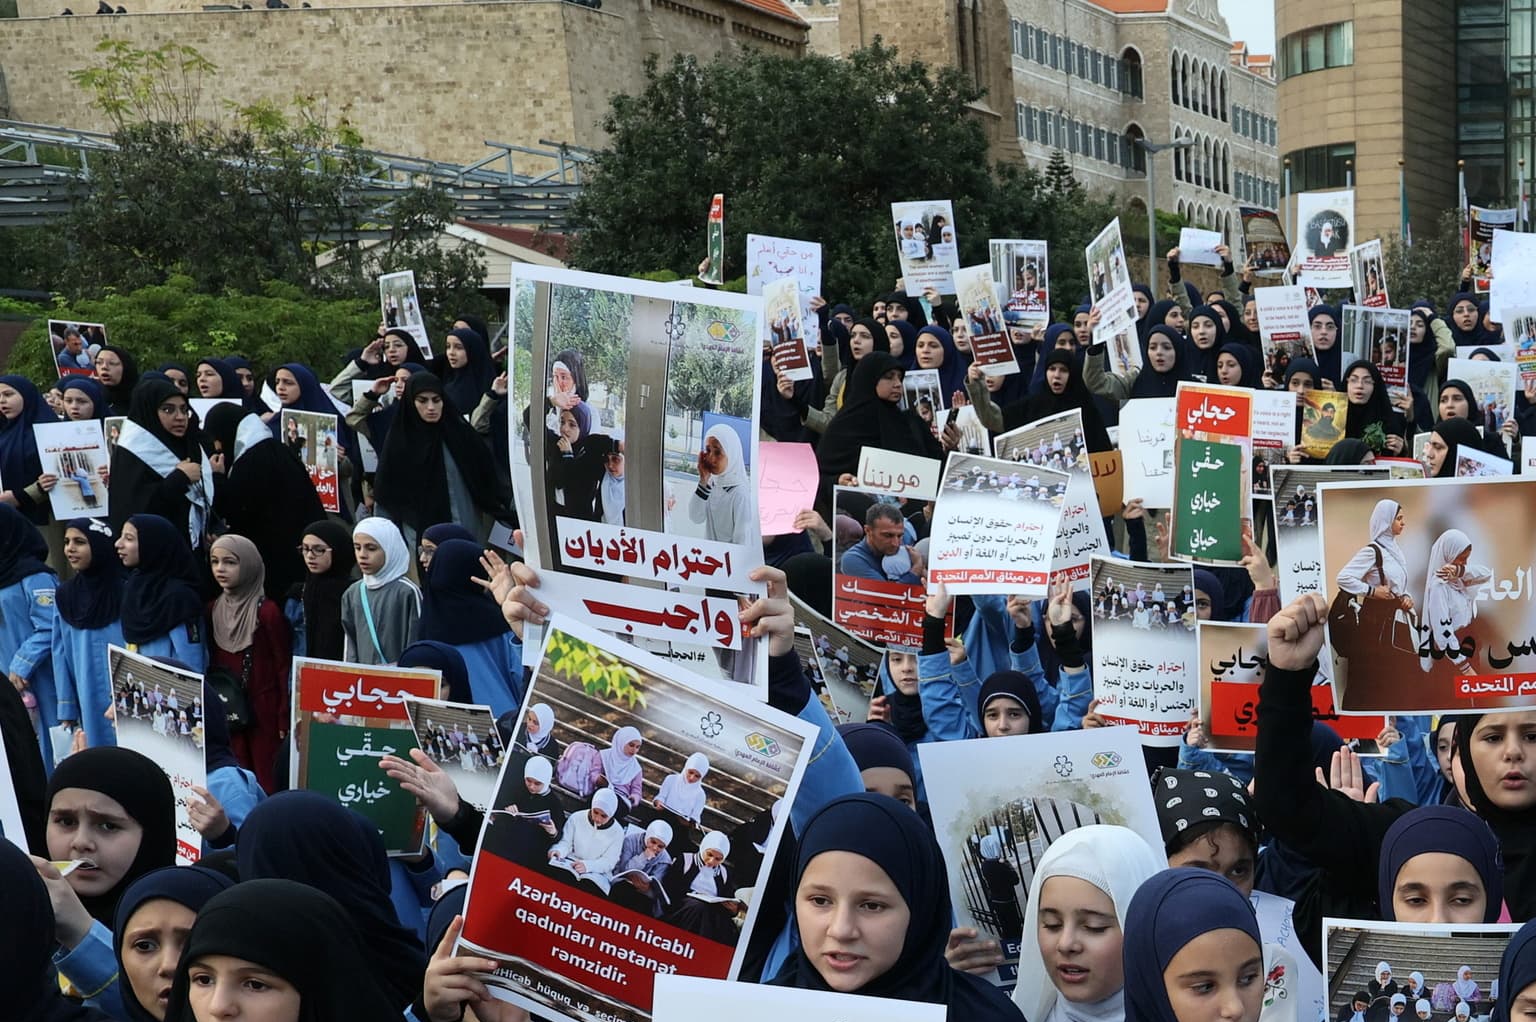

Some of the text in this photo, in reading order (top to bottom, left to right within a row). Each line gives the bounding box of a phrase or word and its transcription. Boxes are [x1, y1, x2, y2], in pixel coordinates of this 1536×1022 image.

[1187, 397, 1236, 429] حجابي
[862, 458, 921, 493] هويتنا
[1190, 491, 1221, 515] خياري
[564, 528, 732, 583] احترام الأديان
[1189, 529, 1218, 556] حياتي
[936, 570, 1041, 584] من ميثاق الأمم المتحدة
[582, 597, 735, 648] واجب
[1102, 655, 1185, 677] إحترام حقوق الإنسان
[323, 677, 417, 713] حجابي
[1143, 682, 1184, 694] والحريات
[1461, 678, 1515, 693] المتحدة
[1161, 699, 1194, 713] الجنس
[1152, 726, 1178, 735] ميثاق
[339, 780, 391, 807] خياري
[507, 876, 696, 961] Azərbaycanın hicablı
[514, 904, 596, 956] qadınları
[550, 943, 629, 988] rəmzidir.
